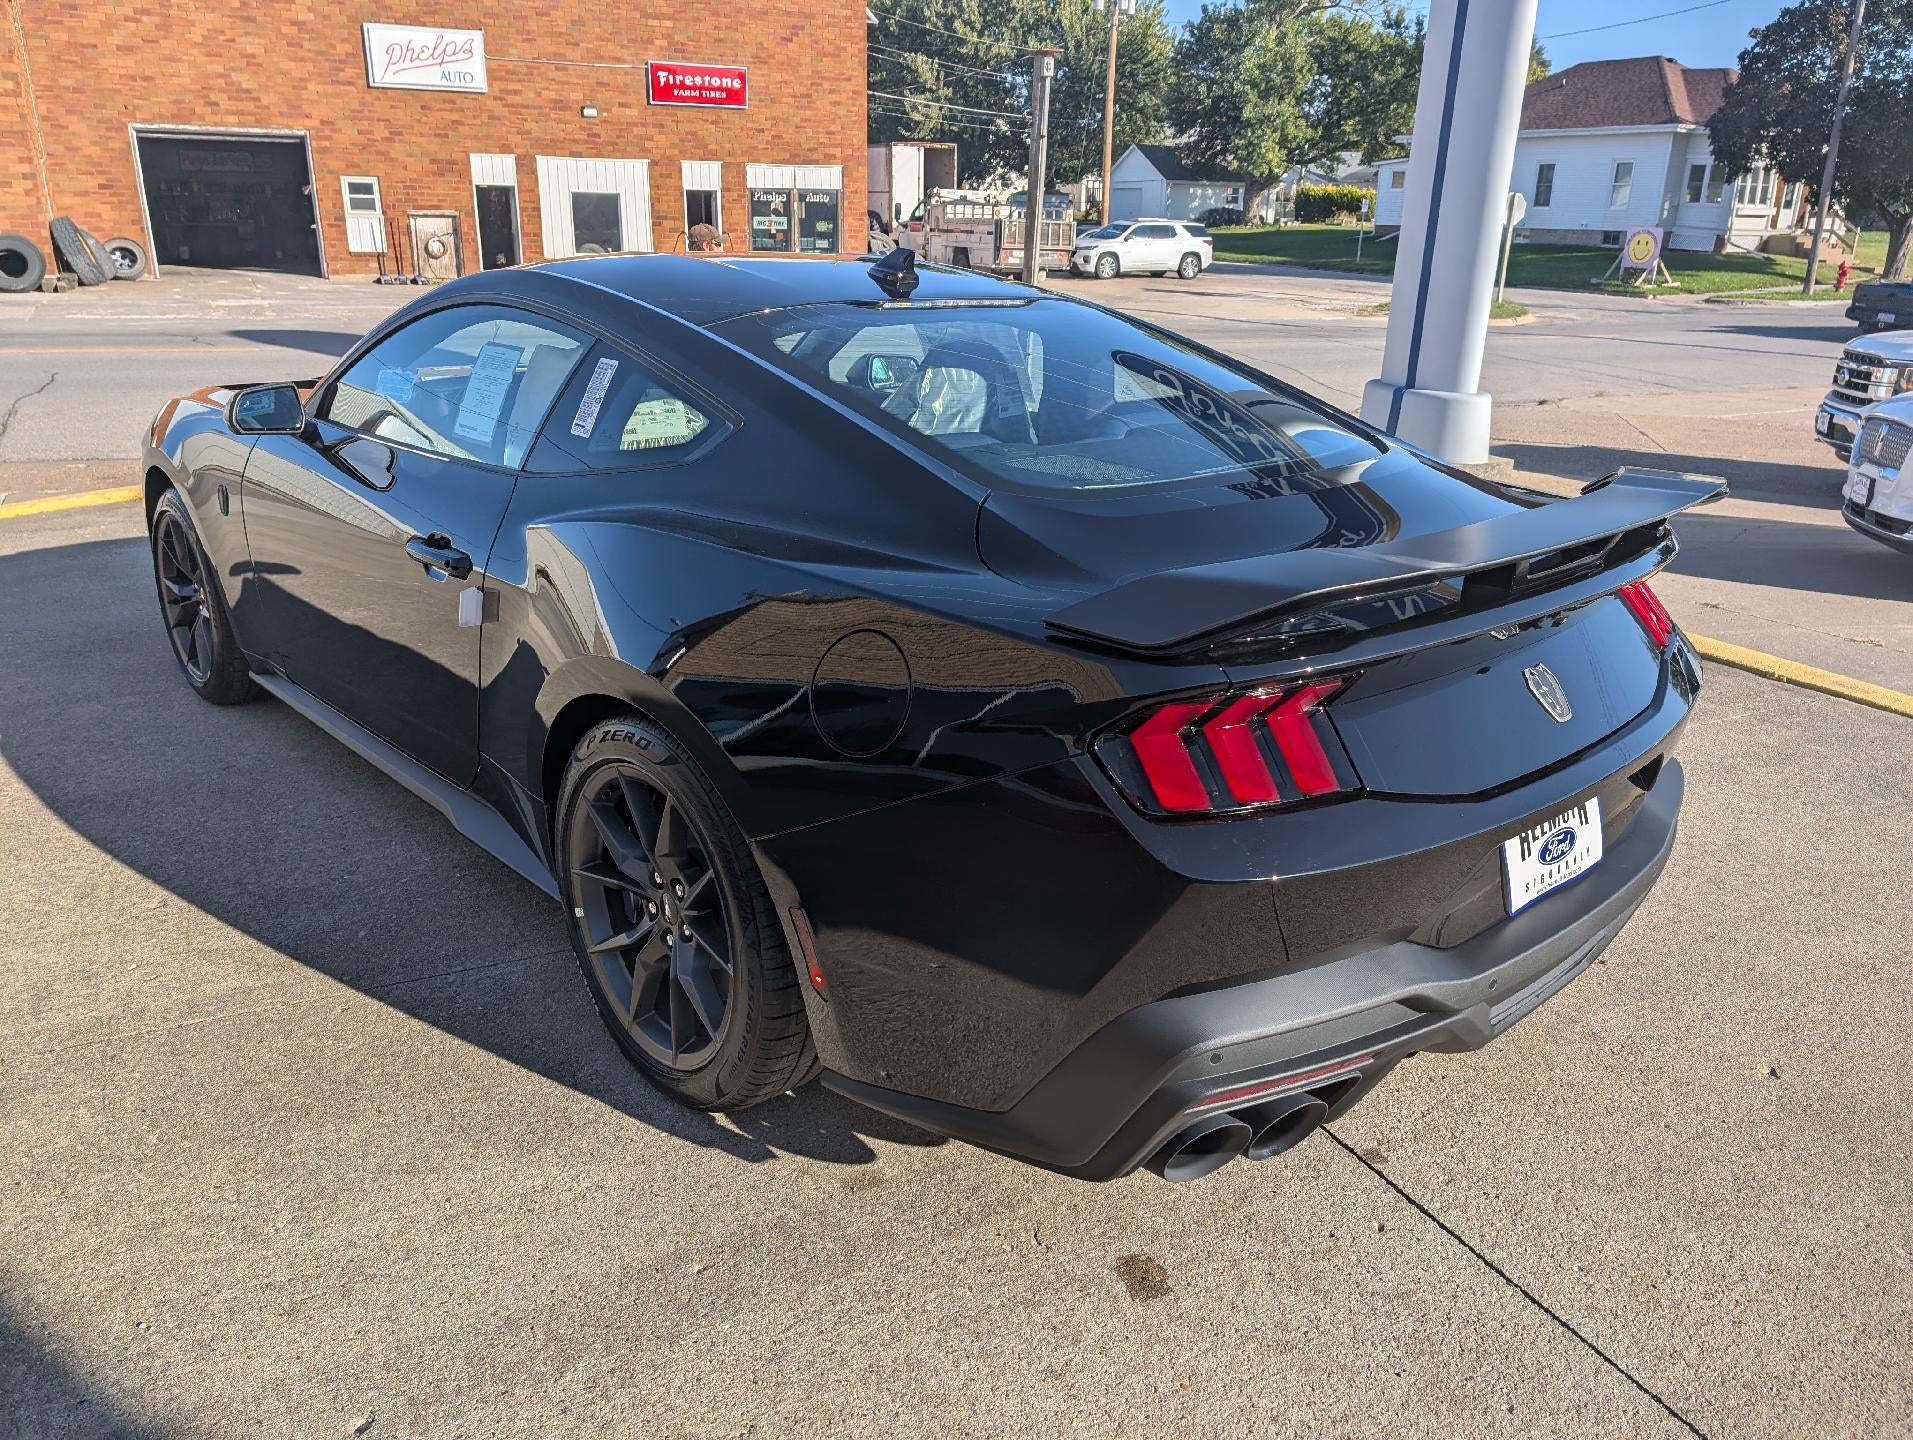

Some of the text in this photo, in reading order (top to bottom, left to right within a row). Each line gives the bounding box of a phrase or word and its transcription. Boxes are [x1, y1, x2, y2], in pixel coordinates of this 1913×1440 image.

[381, 33, 475, 80] Phelps
[440, 70, 474, 84] AUTO
[656, 70, 742, 90] Firestone
[673, 88, 727, 99] FARM TIRES
[805, 192, 830, 203] Auto
[586, 729, 652, 751] P ZERO
[1544, 833, 1572, 862] Ford
